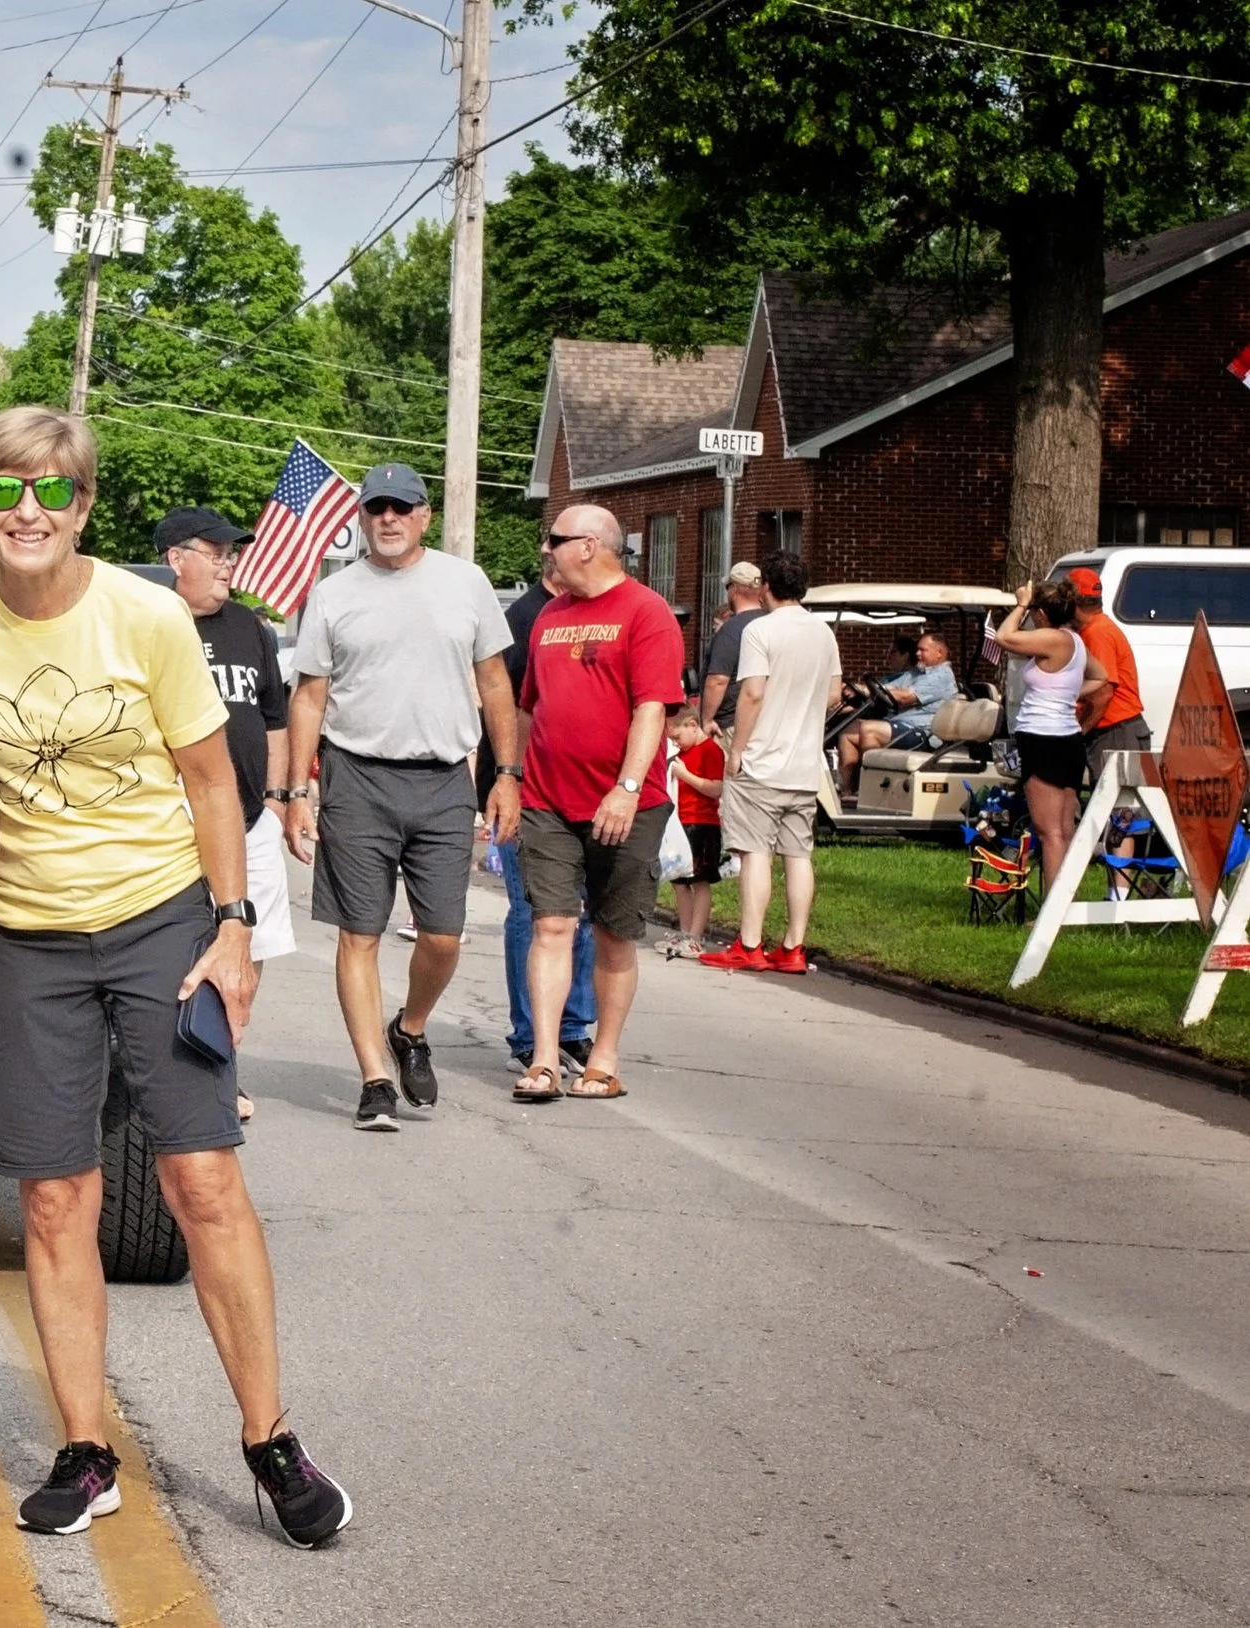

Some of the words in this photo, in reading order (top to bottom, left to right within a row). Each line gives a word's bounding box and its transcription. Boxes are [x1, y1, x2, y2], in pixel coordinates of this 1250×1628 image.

[705, 432, 757, 452] LABETTE
[1180, 705, 1224, 747] STREET
[1176, 776, 1231, 817] CLOSED
